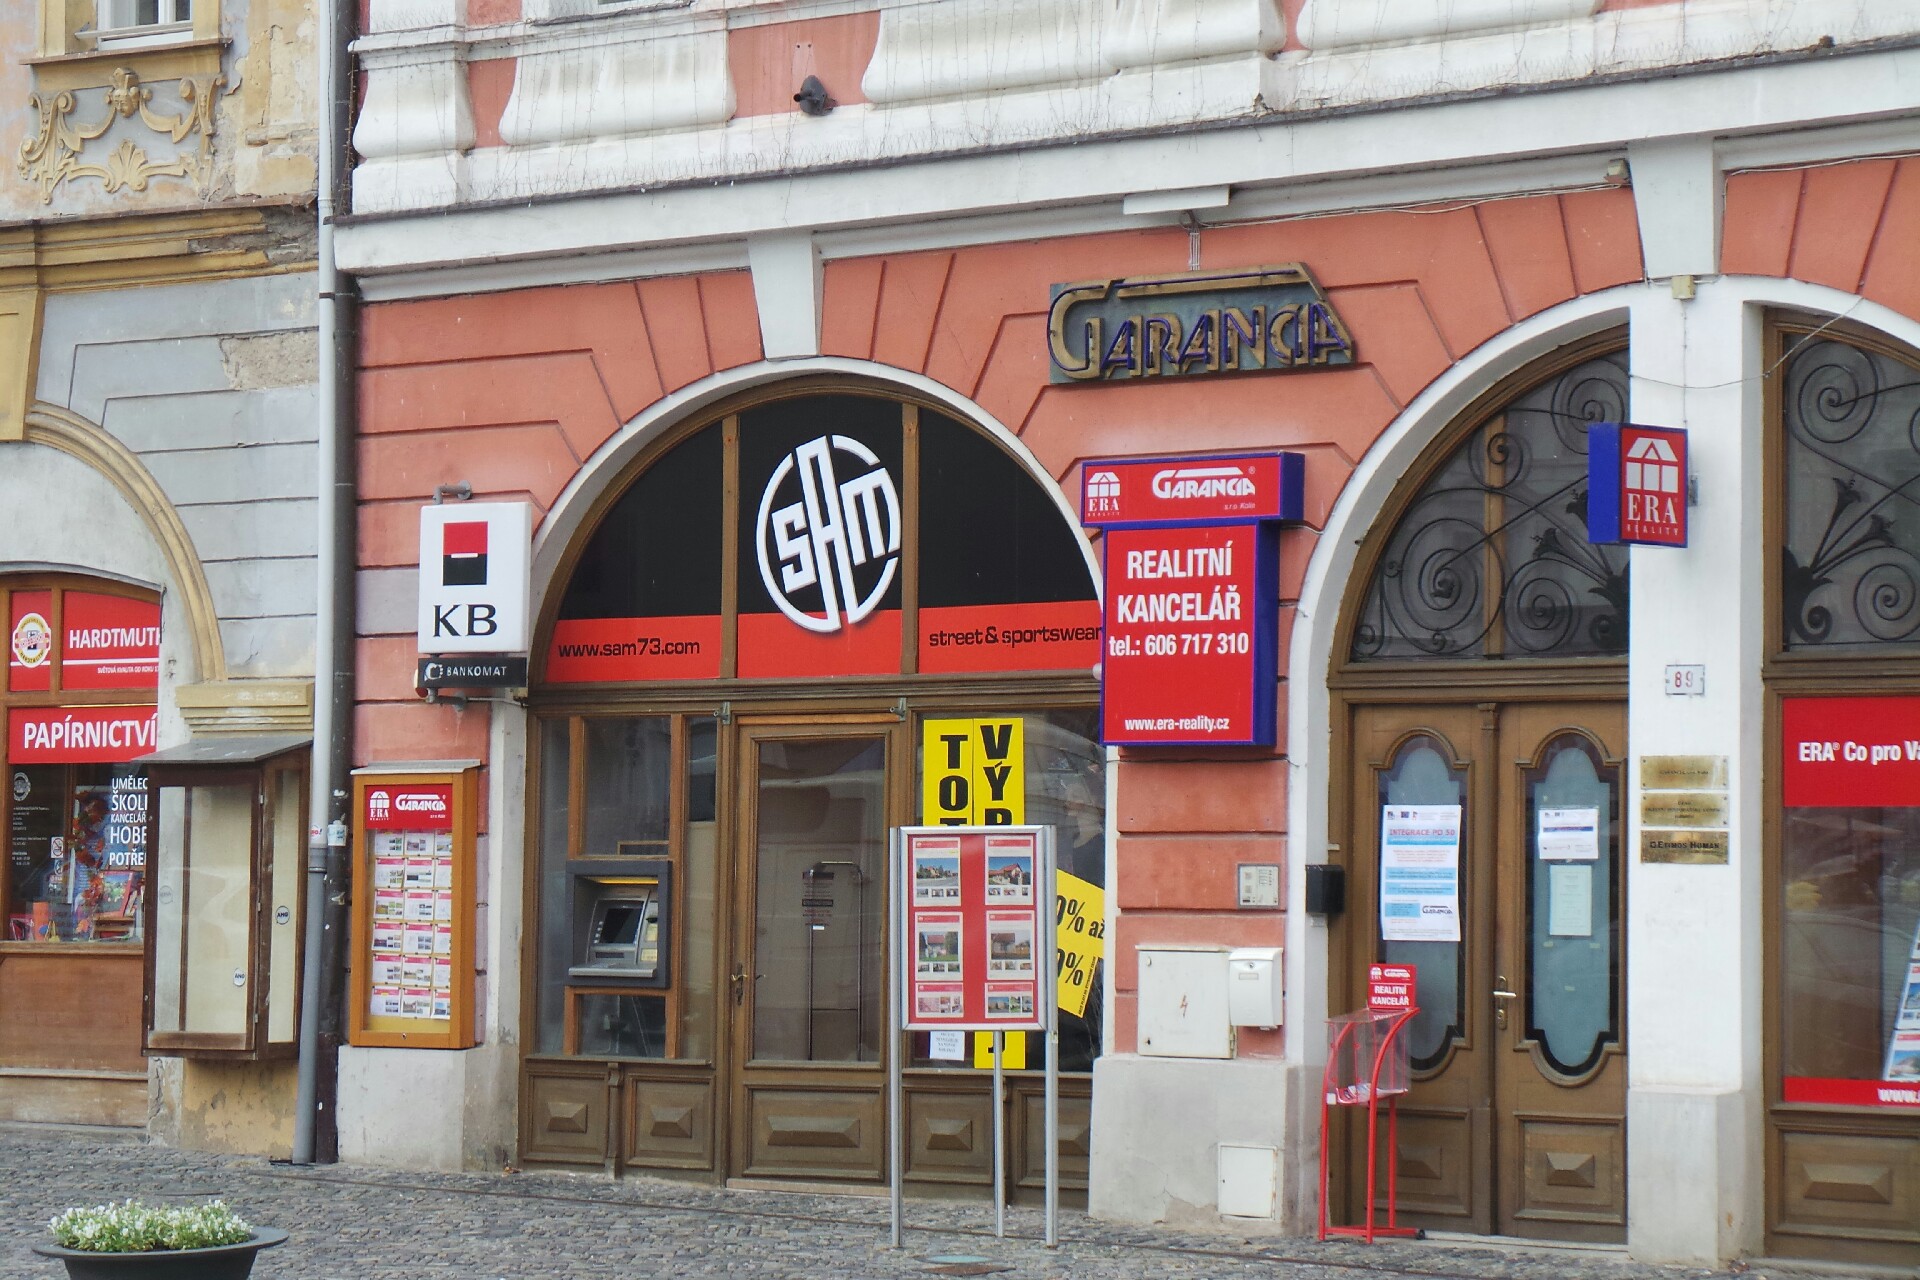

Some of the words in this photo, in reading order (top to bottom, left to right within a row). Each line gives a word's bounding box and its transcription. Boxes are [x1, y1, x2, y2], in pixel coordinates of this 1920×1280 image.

[1047, 262, 1352, 379] GARANCIA
[1152, 467, 1255, 499] GARANCIA
[1089, 498, 1119, 511] ERA
[1627, 492, 1677, 524] ERA
[1627, 524, 1679, 536] REALITY
[1127, 541, 1233, 579] REALITNÍ
[1117, 585, 1241, 623] KANCELÁŘ
[433, 603, 498, 637] KB
[929, 629, 983, 646] street
[985, 626, 999, 644] &
[1002, 625, 1102, 648] sportswear
[1109, 635, 1141, 656] tel.:
[1145, 634, 1177, 656] 606
[1181, 633, 1214, 655] 717
[1217, 632, 1249, 654] 310
[558, 638, 700, 657] www.sam73.com
[446, 666, 507, 677] BANKOMAT
[24, 713, 158, 748] PAPÍRNICTVÍ
[1125, 716, 1230, 733] www.era-reality.cz
[1844, 741, 1867, 762] Co
[1871, 744, 1902, 766] pro
[111, 774, 149, 790] UMĚLEC
[370, 808, 389, 818] ERA
[395, 794, 446, 811] GARANCIA
[109, 848, 147, 866] POTŘE
[1374, 985, 1407, 994] REALITNÍ
